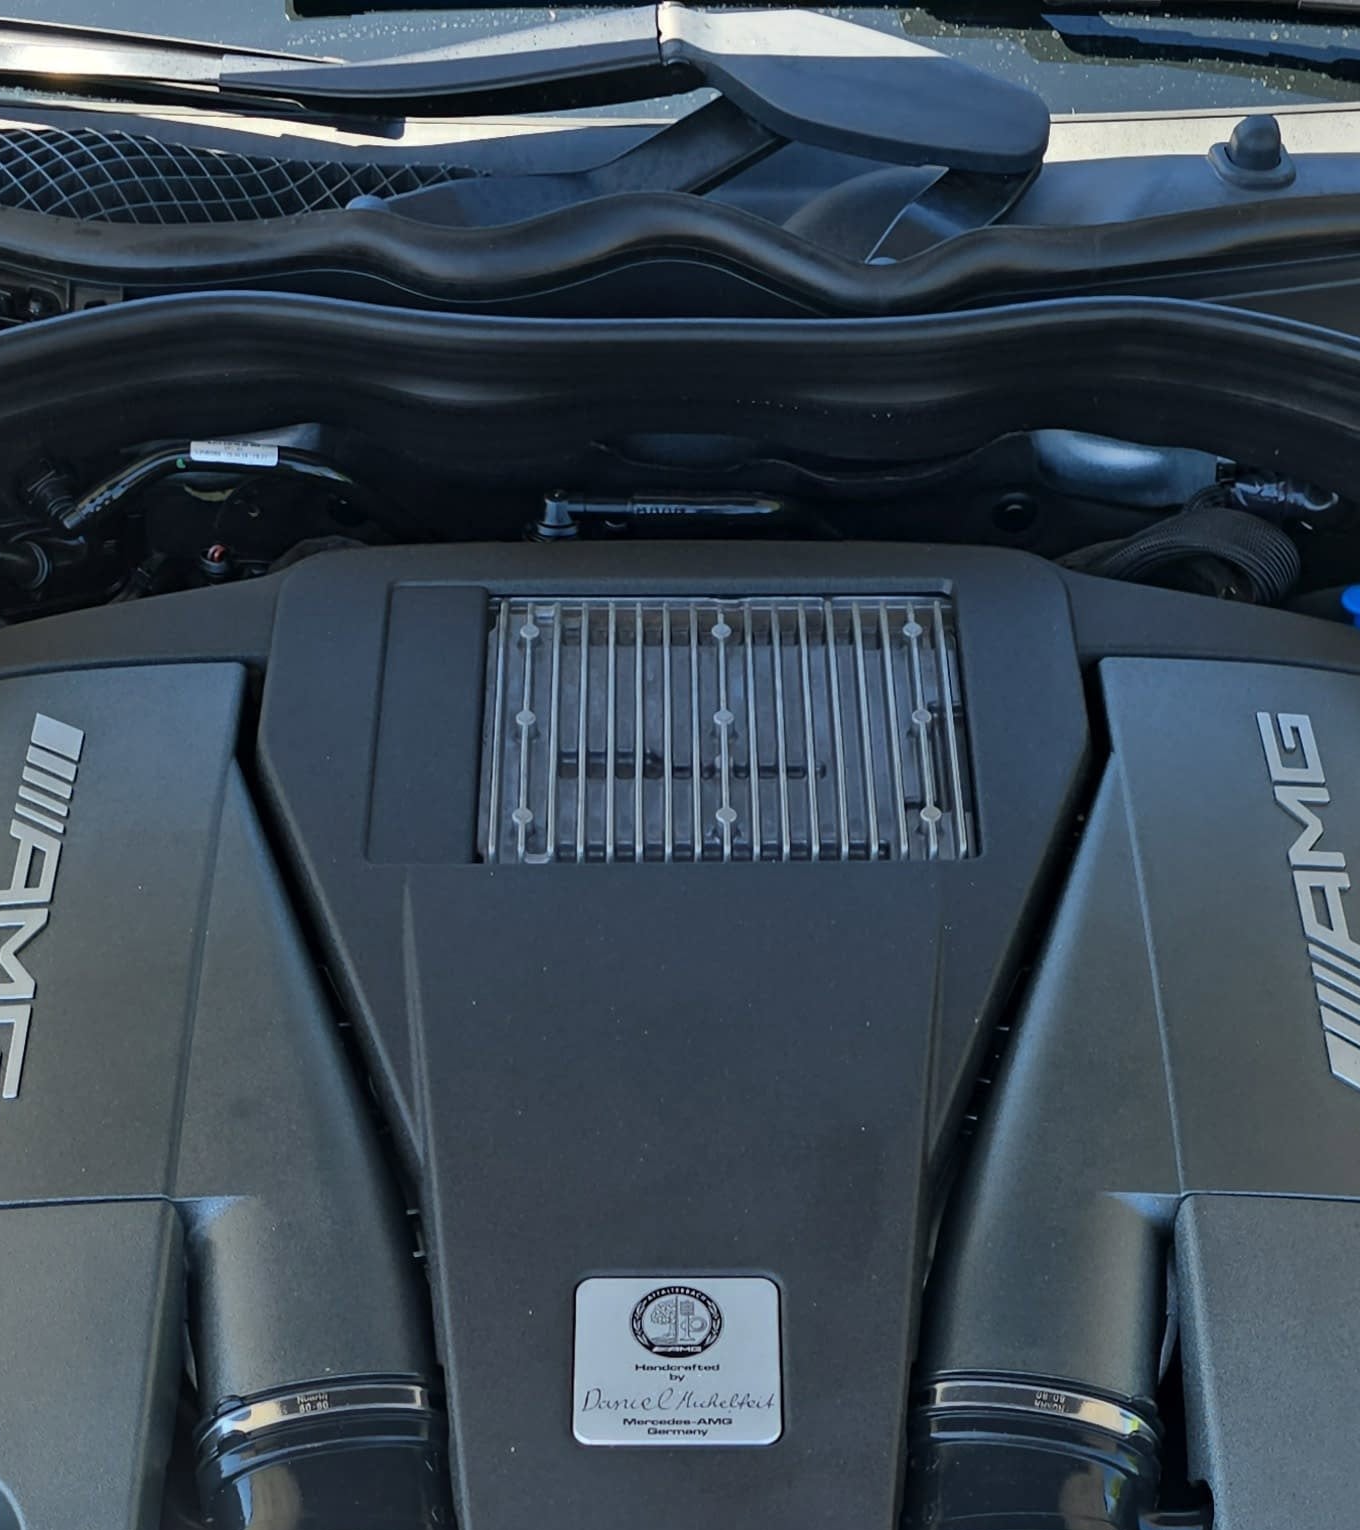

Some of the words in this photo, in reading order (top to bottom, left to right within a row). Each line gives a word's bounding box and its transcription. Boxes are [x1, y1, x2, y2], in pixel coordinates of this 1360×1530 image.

[635, 1363, 720, 1372] Handcrafted
[669, 1373, 685, 1382] by
[623, 1417, 733, 1426] Mercedes-AMG
[647, 1427, 709, 1437] Germany
